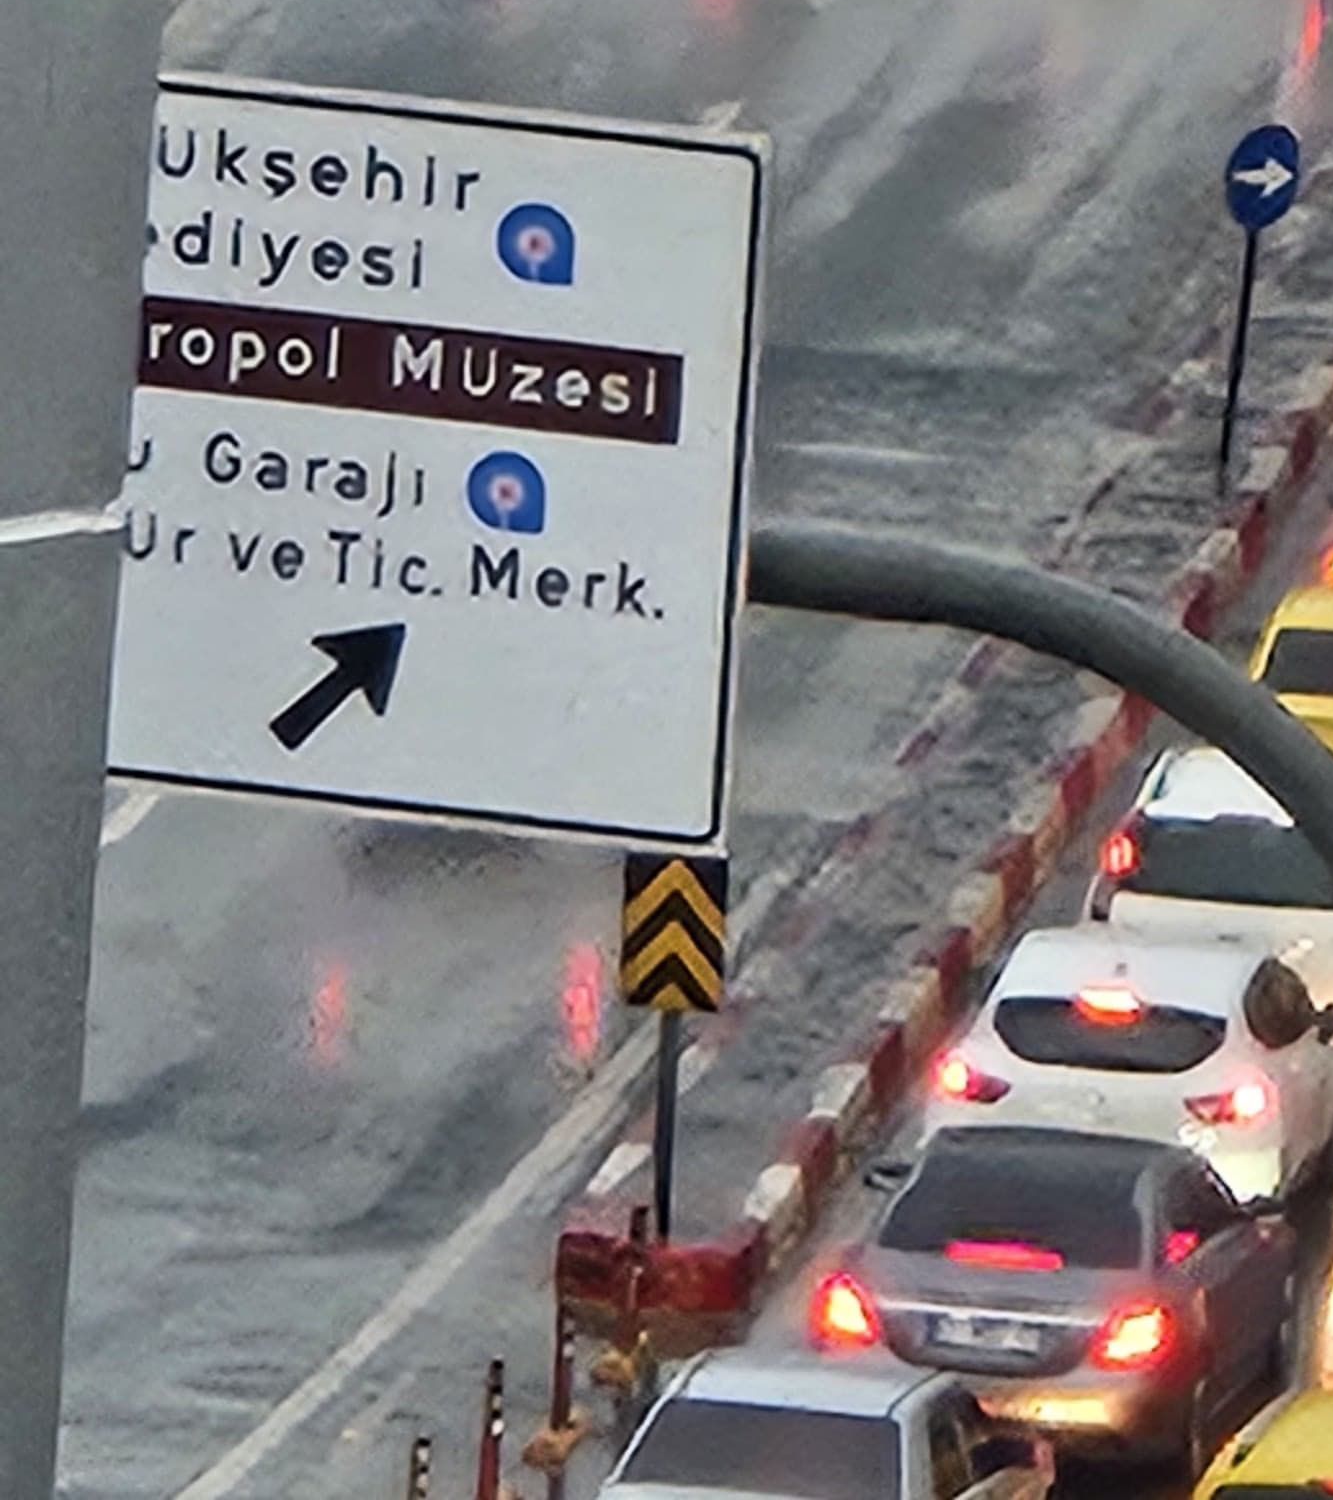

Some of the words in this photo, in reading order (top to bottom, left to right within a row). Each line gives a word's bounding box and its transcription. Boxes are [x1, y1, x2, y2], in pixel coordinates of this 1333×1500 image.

[148, 322, 341, 384] ropol
[204, 431, 425, 517] Garajı
[228, 530, 306, 580] ve
[327, 530, 444, 597] Tic.
[470, 543, 666, 620] Merk.
